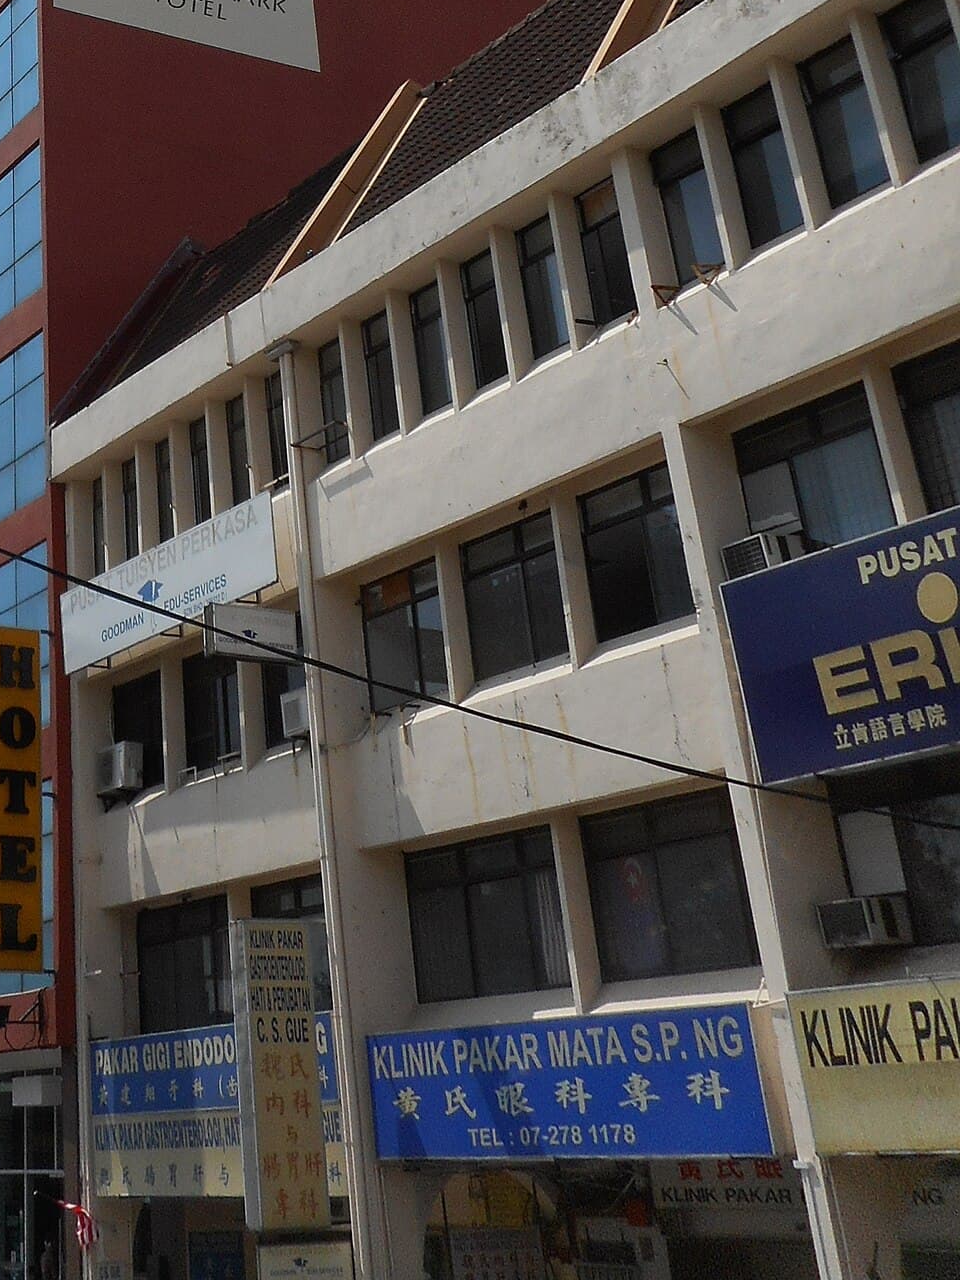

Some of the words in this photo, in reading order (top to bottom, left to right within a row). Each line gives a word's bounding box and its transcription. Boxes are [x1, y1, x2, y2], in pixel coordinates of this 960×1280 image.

[181, 504, 258, 561] PERKASA
[856, 527, 958, 585] PUSAT
[101, 611, 145, 643] GOODMAN
[163, 573, 228, 612] EDU-SERVICES
[833, 703, 947, 750] 立肯語言學院
[249, 930, 275, 949] KLINIK
[277, 930, 304, 950] PAKAR
[272, 986, 312, 1012] PERUBATAN
[256, 1017, 269, 1043] C.
[271, 1017, 283, 1043] S.
[285, 1017, 310, 1043] GUE
[373, 1040, 449, 1080] KLINIK
[453, 1033, 542, 1073] PAKAR
[546, 1025, 628, 1068] MATA
[633, 1021, 688, 1064] S.P.
[692, 1016, 744, 1058] NG
[800, 1003, 903, 1068] KLINIK
[95, 1045, 139, 1076] PAKAR
[142, 1041, 171, 1071] GIGI
[174, 1033, 239, 1068] ENDODO
[95, 1123, 120, 1151] KLINIK
[120, 1121, 144, 1151] PAKAR
[467, 1126, 504, 1147] TEL
[519, 1126, 583, 1147] 07-278
[587, 1124, 637, 1145] 1178
[660, 1186, 718, 1204] KLINIK
[724, 1187, 793, 1205] PAKAR
[911, 1188, 944, 1205] NG
